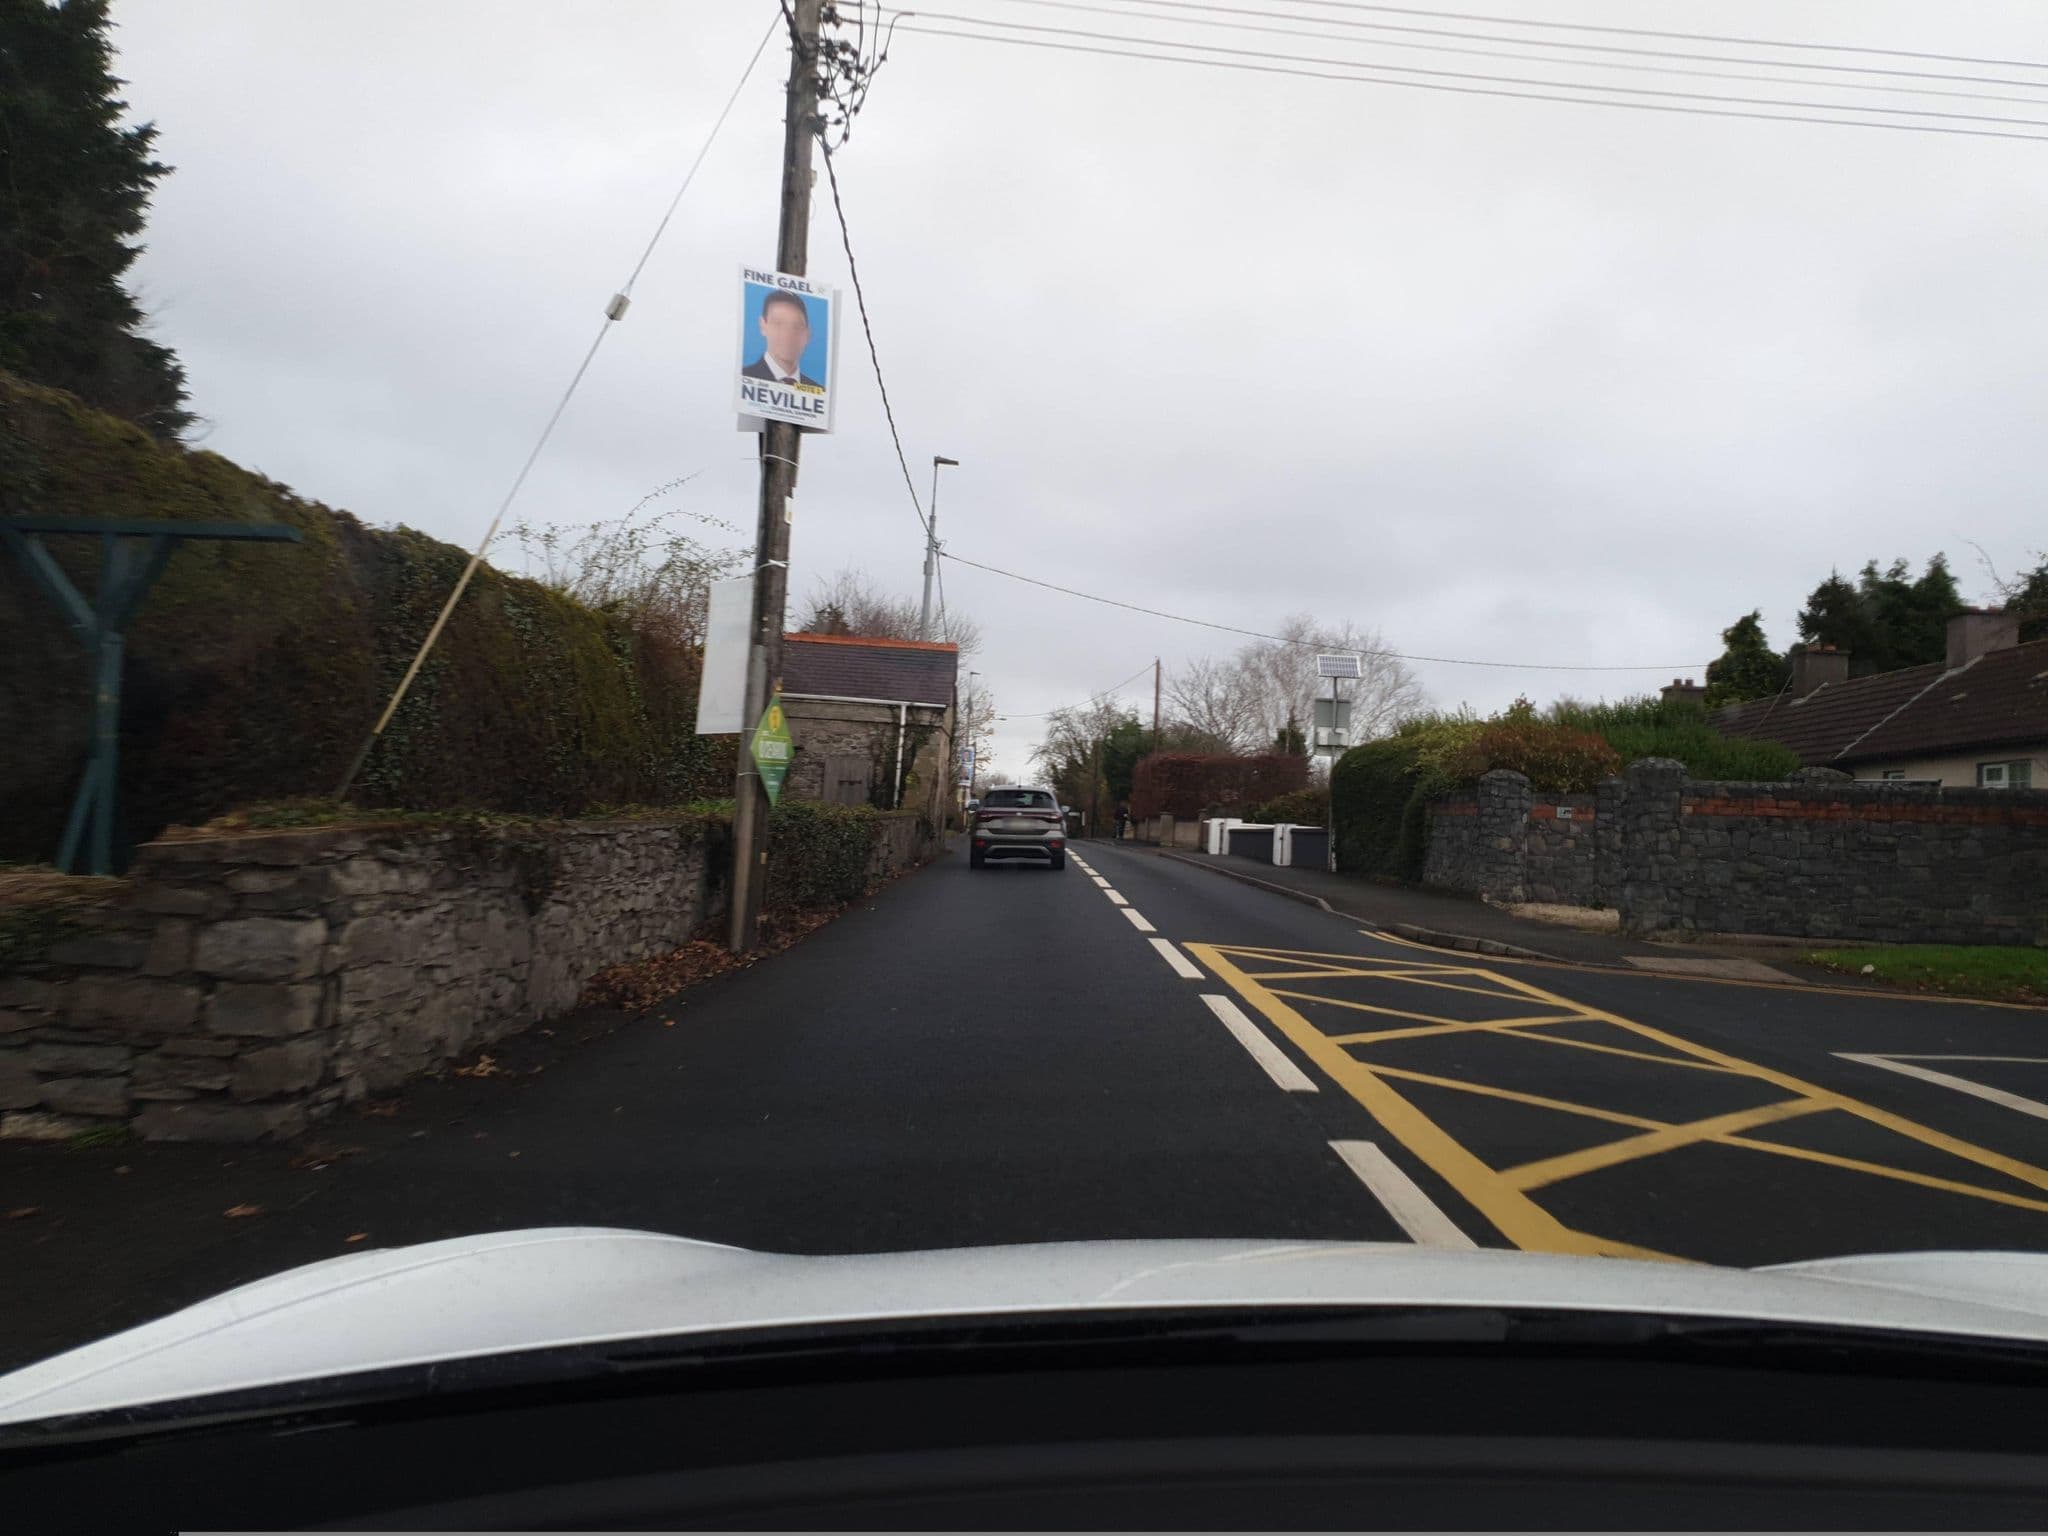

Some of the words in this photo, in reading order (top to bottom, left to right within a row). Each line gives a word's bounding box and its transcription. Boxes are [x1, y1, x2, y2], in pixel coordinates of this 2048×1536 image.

[744, 269, 774, 285] FINE
[777, 276, 813, 294] GAEL
[741, 383, 825, 415] NEVILLE
